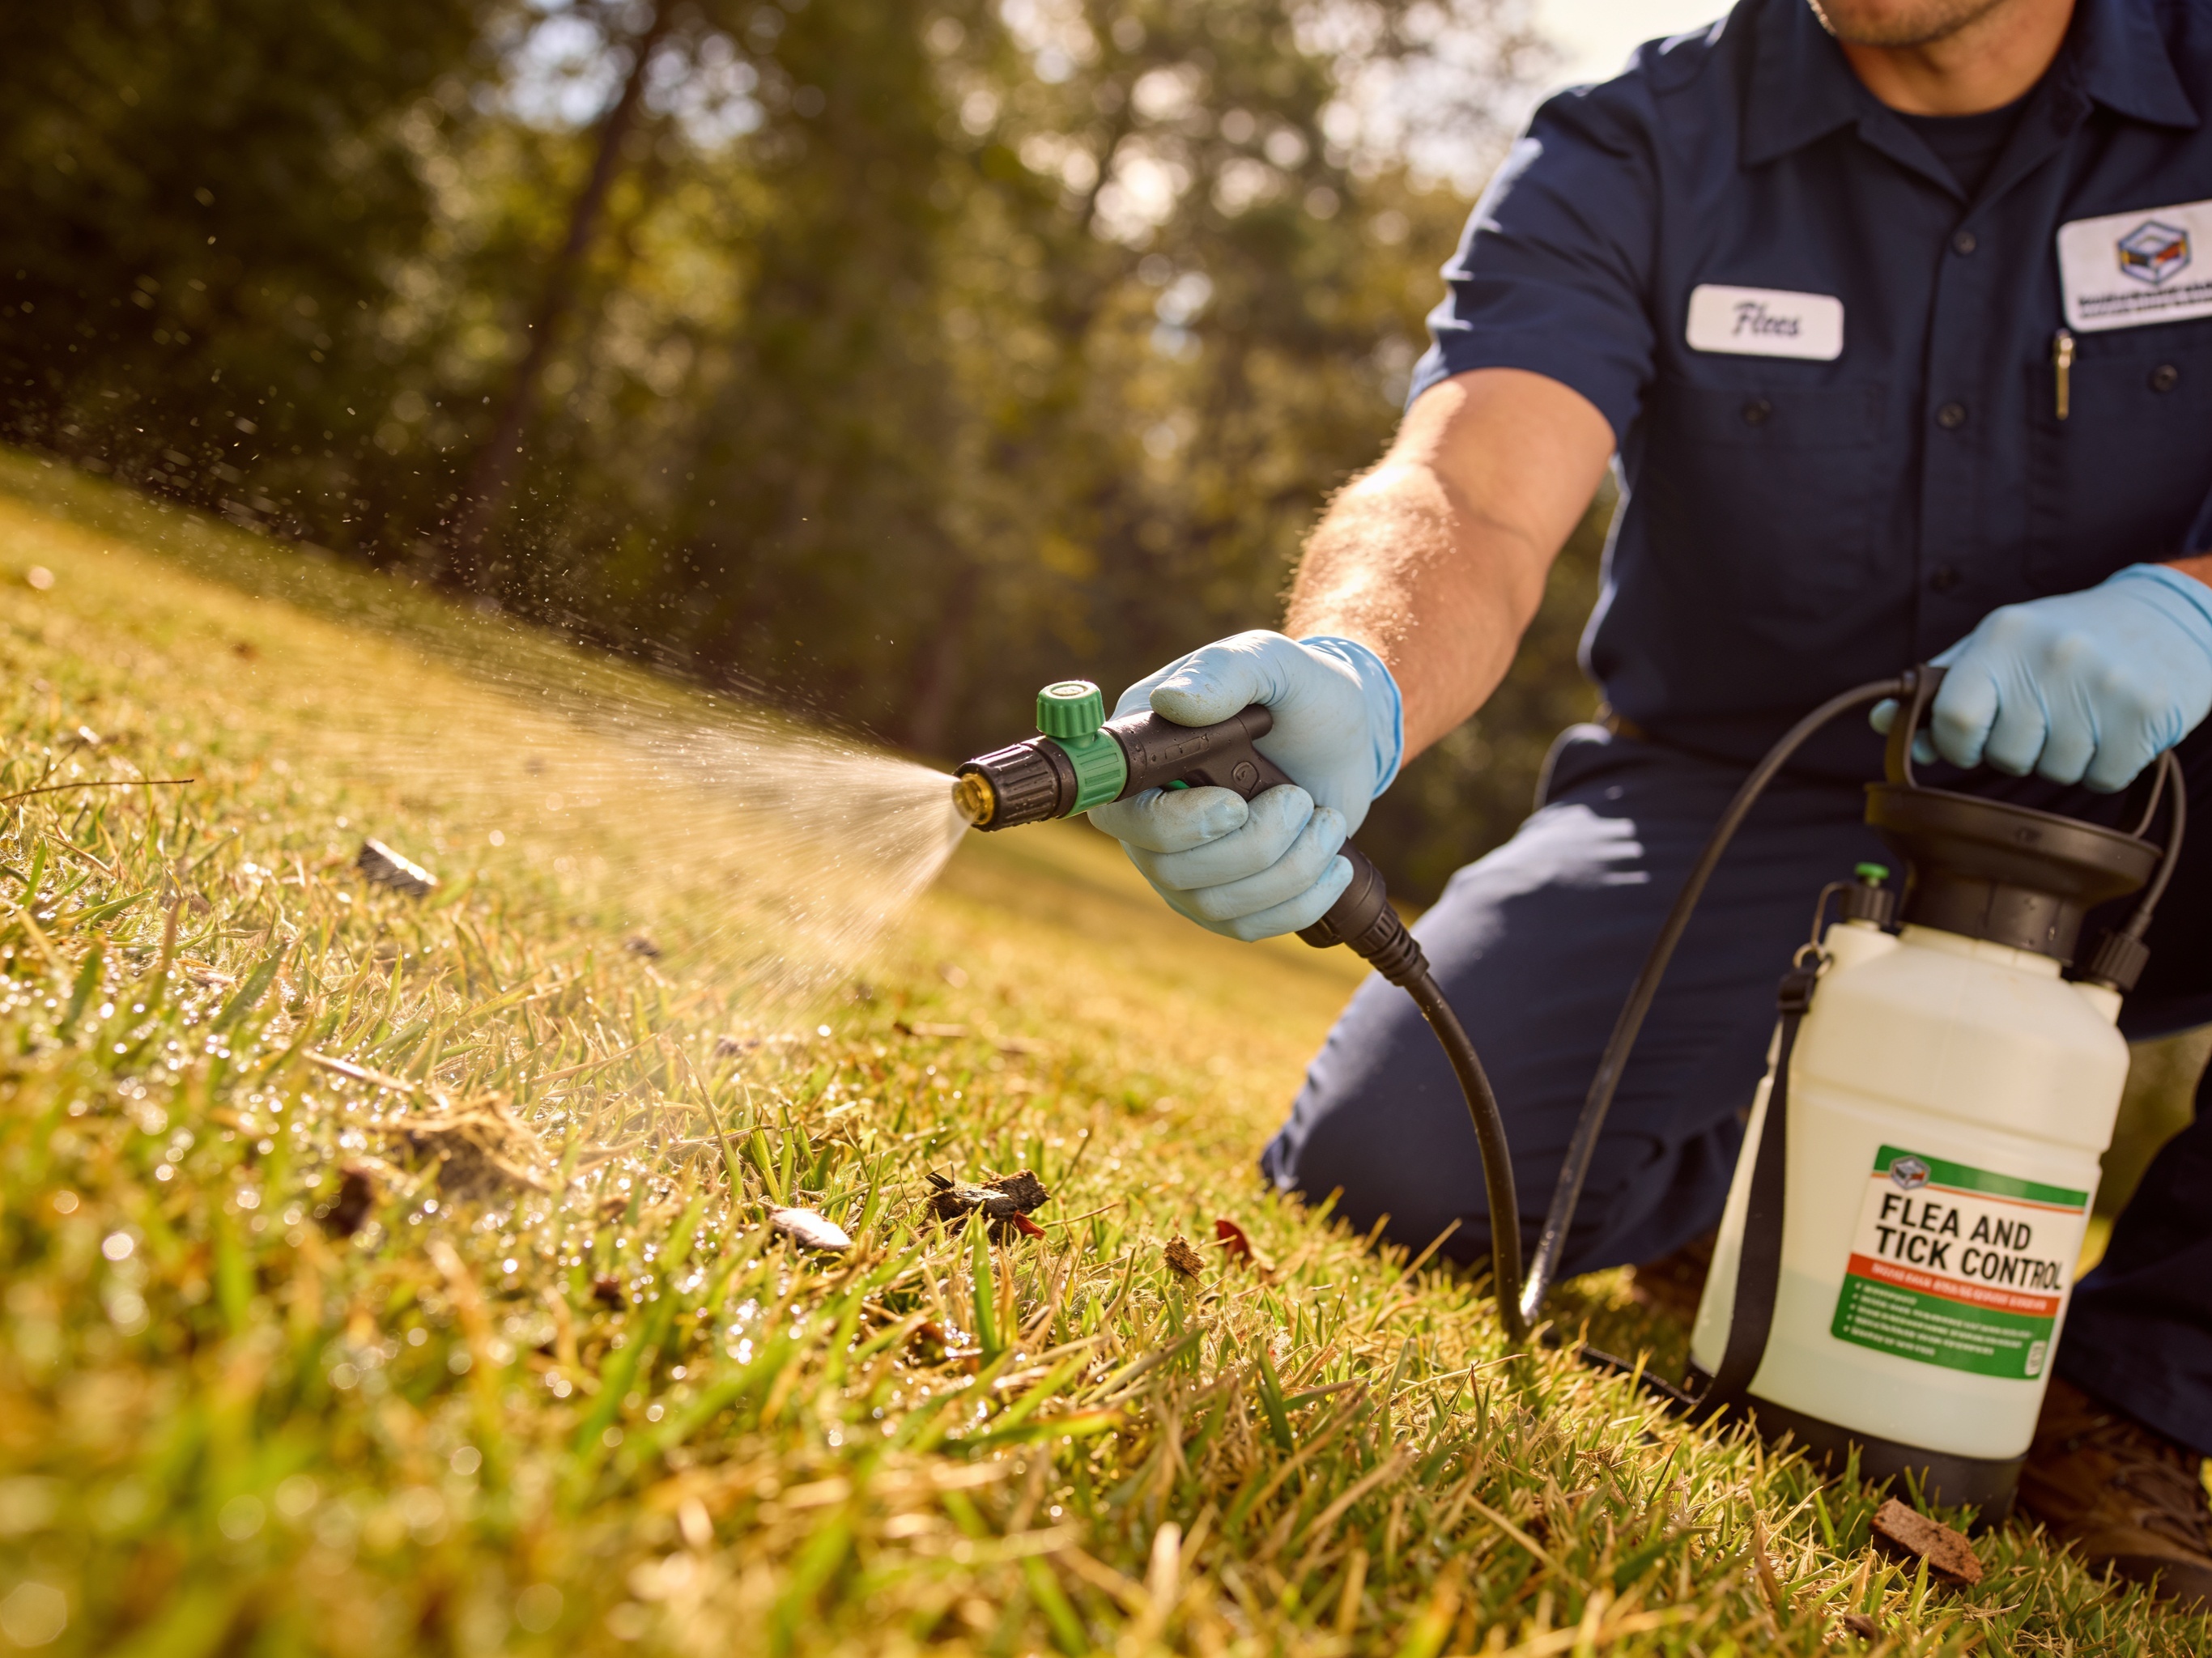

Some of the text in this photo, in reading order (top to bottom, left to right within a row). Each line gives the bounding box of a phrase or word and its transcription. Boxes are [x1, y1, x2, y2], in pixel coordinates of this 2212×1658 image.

[1879, 1192, 2031, 1251] FLEA AND
[1875, 1225, 1952, 1271] TICK
[1960, 1248, 2062, 1290] CONTROL
